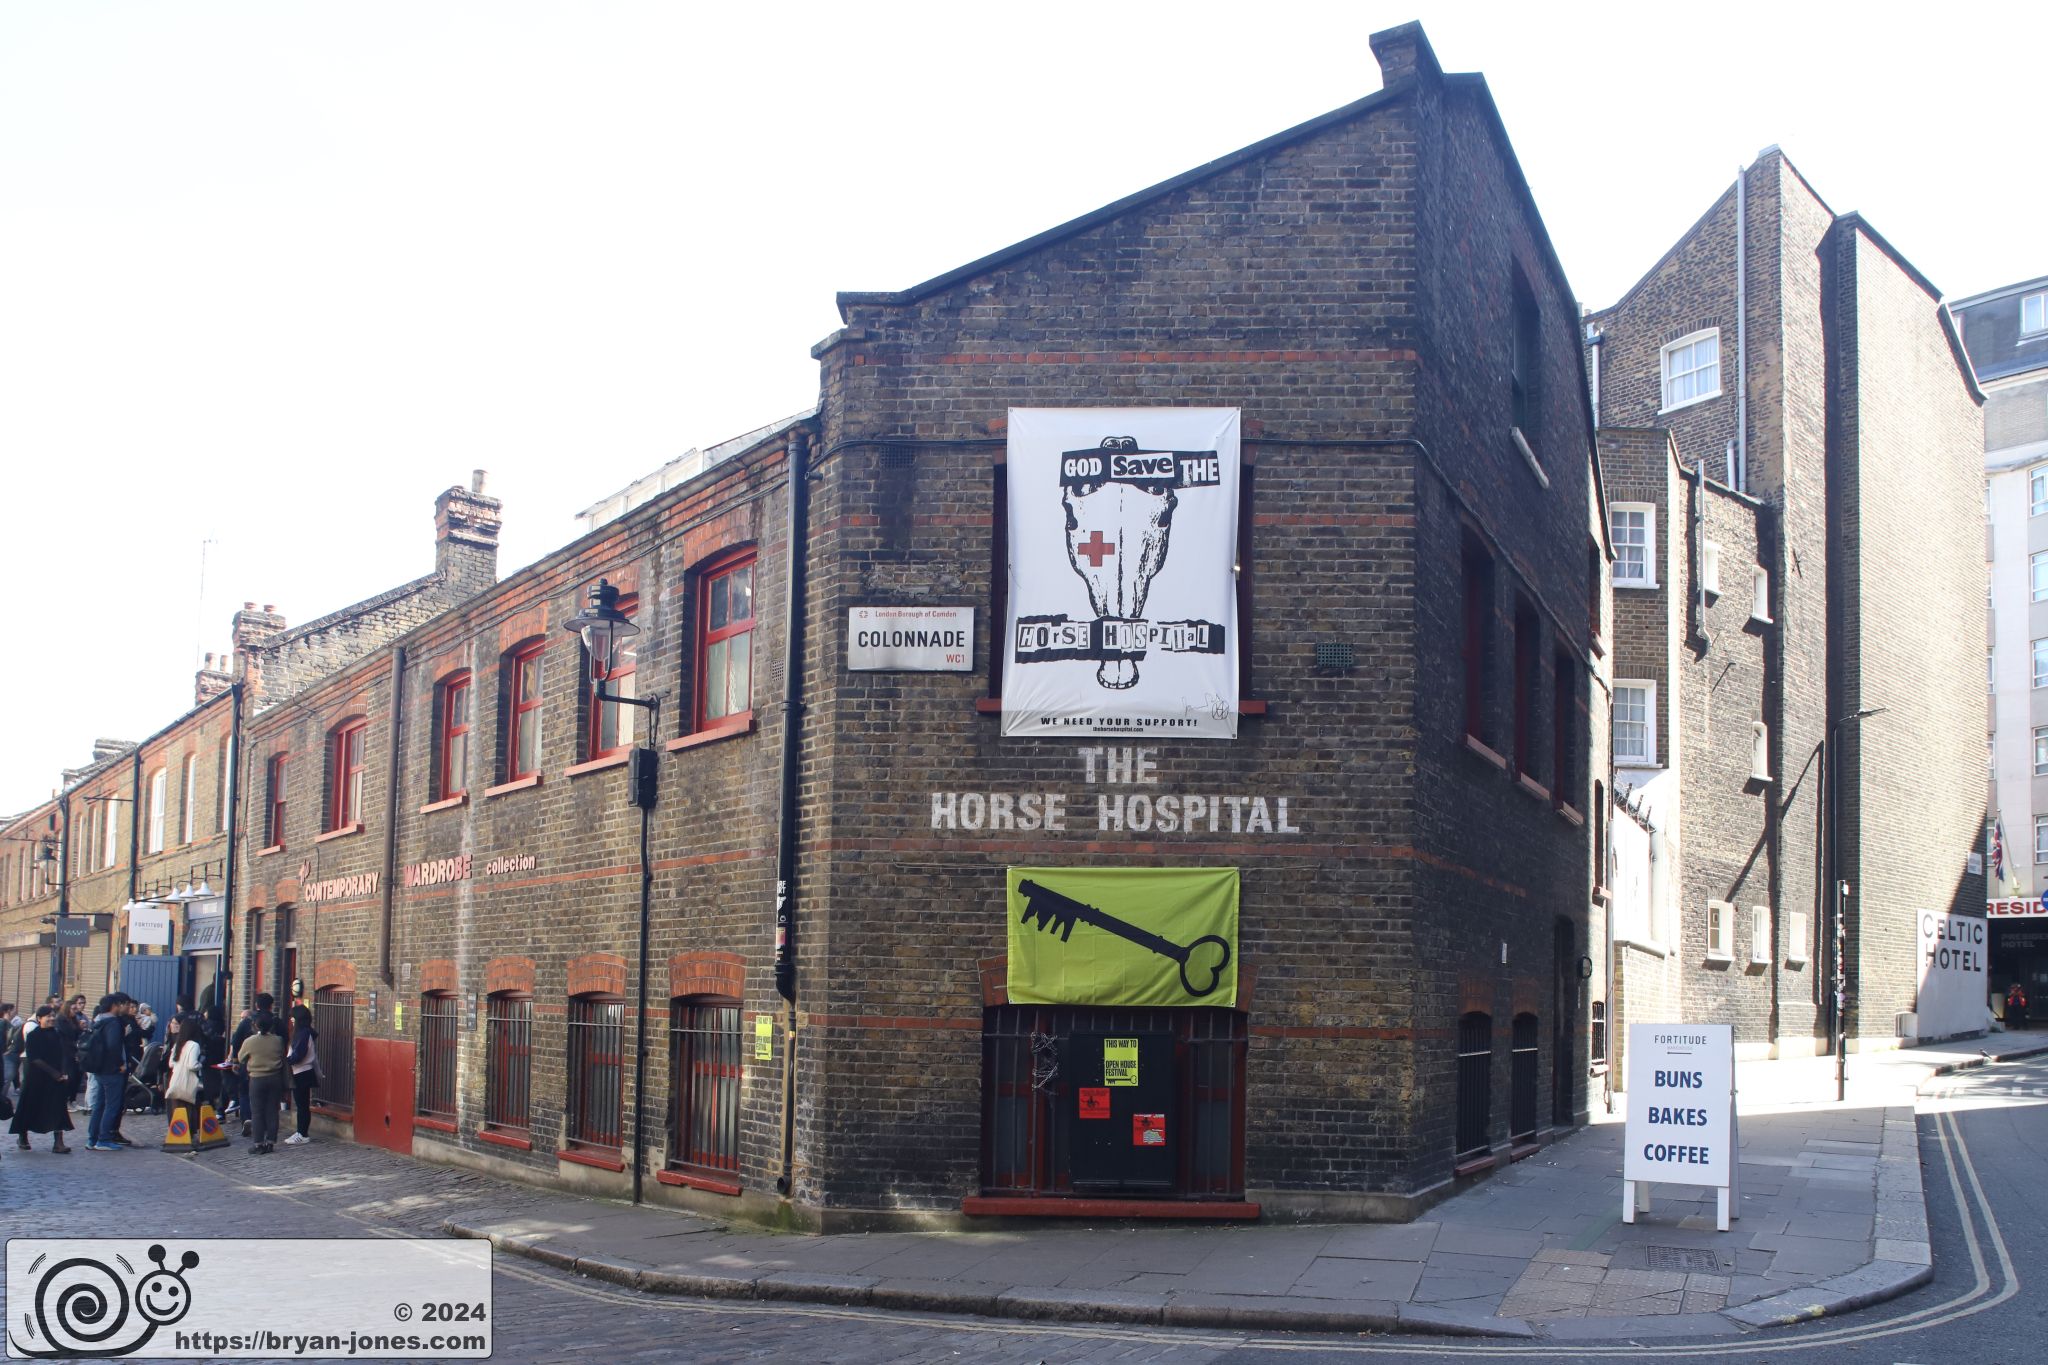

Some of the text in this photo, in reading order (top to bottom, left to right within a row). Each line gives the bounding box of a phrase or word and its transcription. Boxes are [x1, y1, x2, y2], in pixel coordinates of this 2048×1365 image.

[1064, 456, 1218, 487] GOD Save THE
[898, 610, 923, 619] Borough
[858, 630, 965, 648] COLONNADE
[946, 654, 965, 663] WC1
[1040, 717, 1198, 727] WE NEED YOUR SUPPORT!
[1078, 748, 1158, 784] THE
[931, 793, 1300, 834] HORSE HOSPITAL
[403, 854, 536, 888] WARDROBE collection
[305, 872, 380, 902] CONTEMPORARY
[1922, 914, 1983, 945] CELTIC
[1925, 943, 1982, 972] HOTEL
[1106, 1040, 1136, 1048] THIS WAY TO
[1654, 1035, 1707, 1044] FORTITUDE
[1106, 1060, 1136, 1068] OPEN HOUSE
[1106, 1068, 1128, 1076] FESTIVAL
[1654, 1070, 1703, 1089] BUNS
[1648, 1106, 1708, 1126] BAKES
[1644, 1144, 1710, 1164] COFFEE
